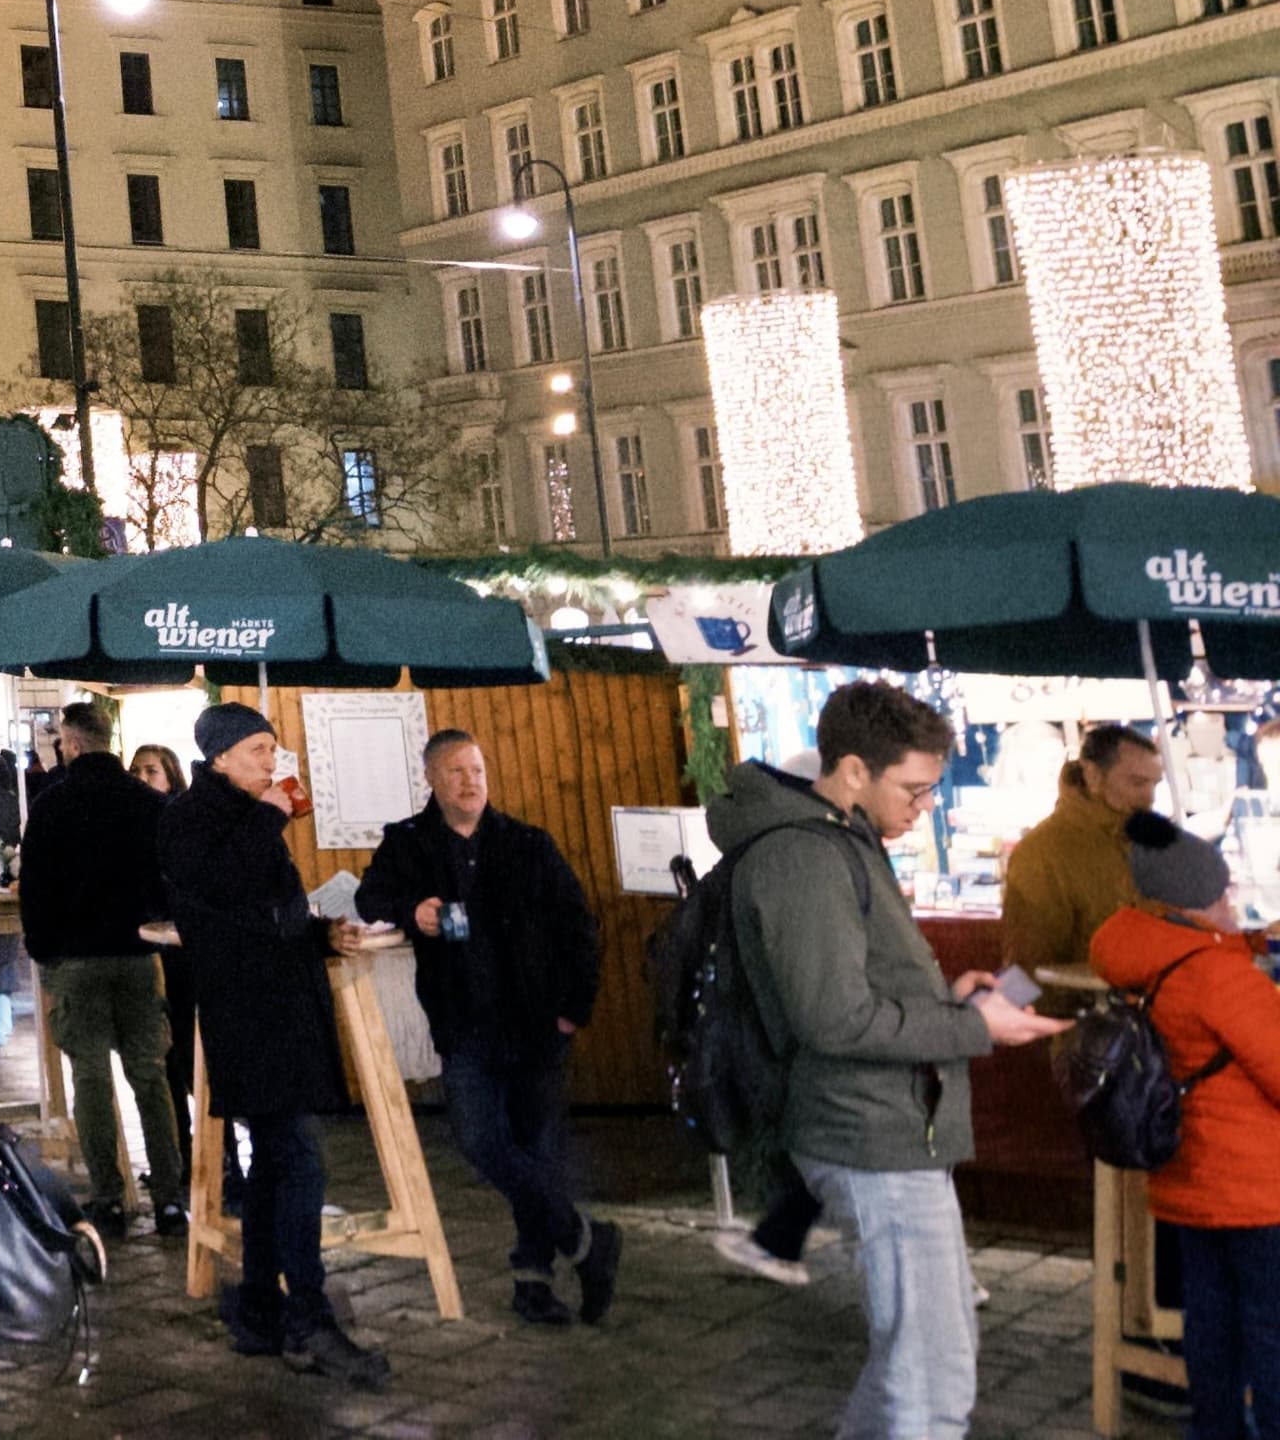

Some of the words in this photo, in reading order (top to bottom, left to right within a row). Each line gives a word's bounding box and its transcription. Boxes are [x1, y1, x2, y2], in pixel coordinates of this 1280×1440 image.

[1145, 548, 1208, 581] alt
[143, 603, 190, 628] alt
[157, 620, 276, 648] wiener
